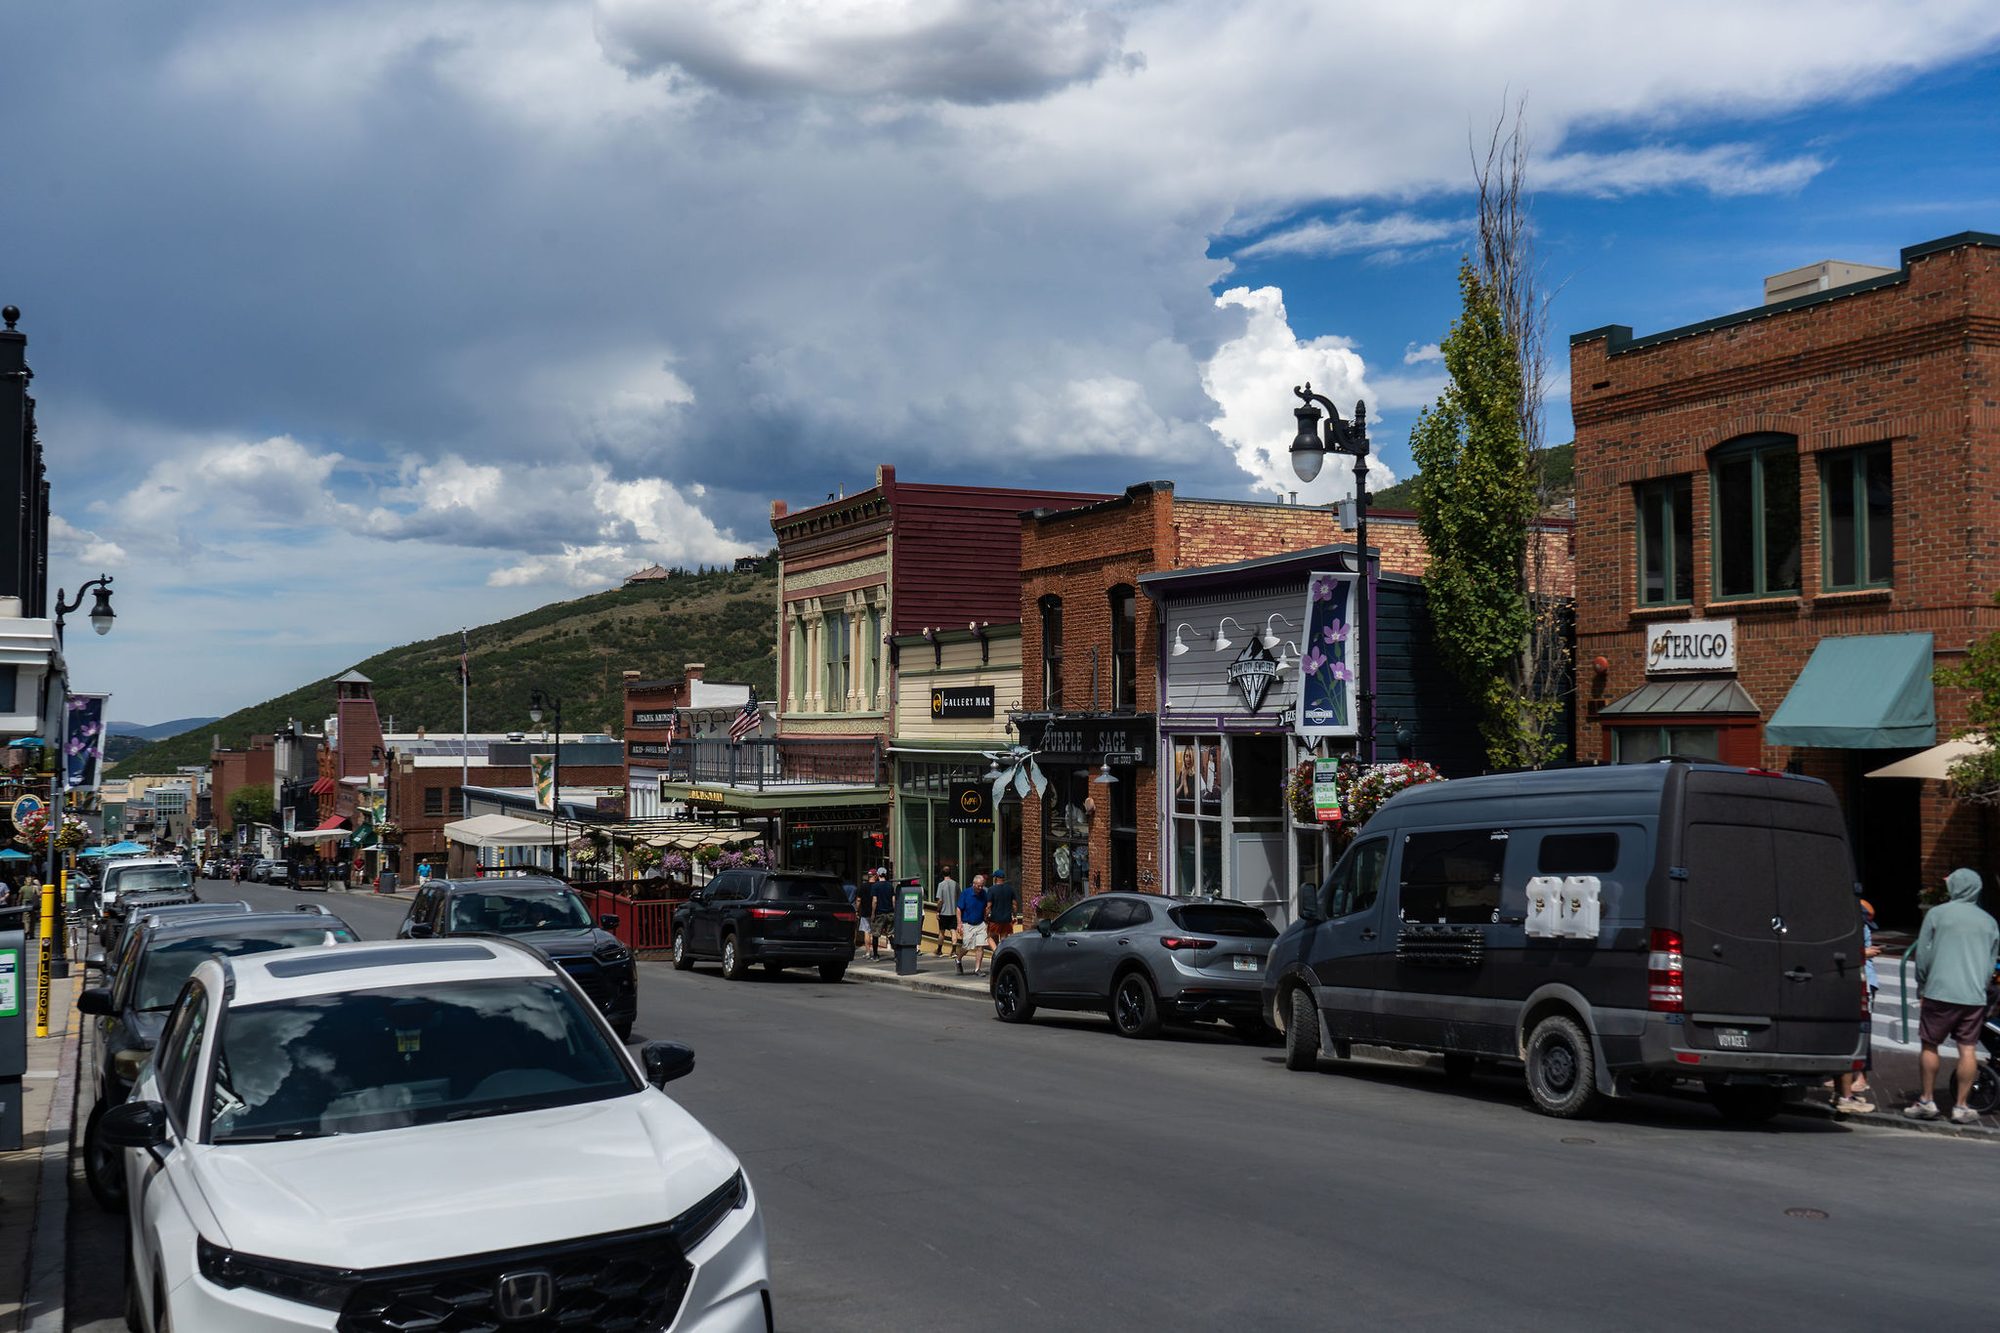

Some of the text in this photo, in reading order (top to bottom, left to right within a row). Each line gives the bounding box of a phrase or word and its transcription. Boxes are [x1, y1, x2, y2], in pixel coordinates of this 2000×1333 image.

[1662, 633, 1727, 659] TERIGO
[944, 698, 973, 707] GALLERY
[975, 697, 990, 706] MAR
[1044, 731, 1126, 752] PURPLE SAGE
